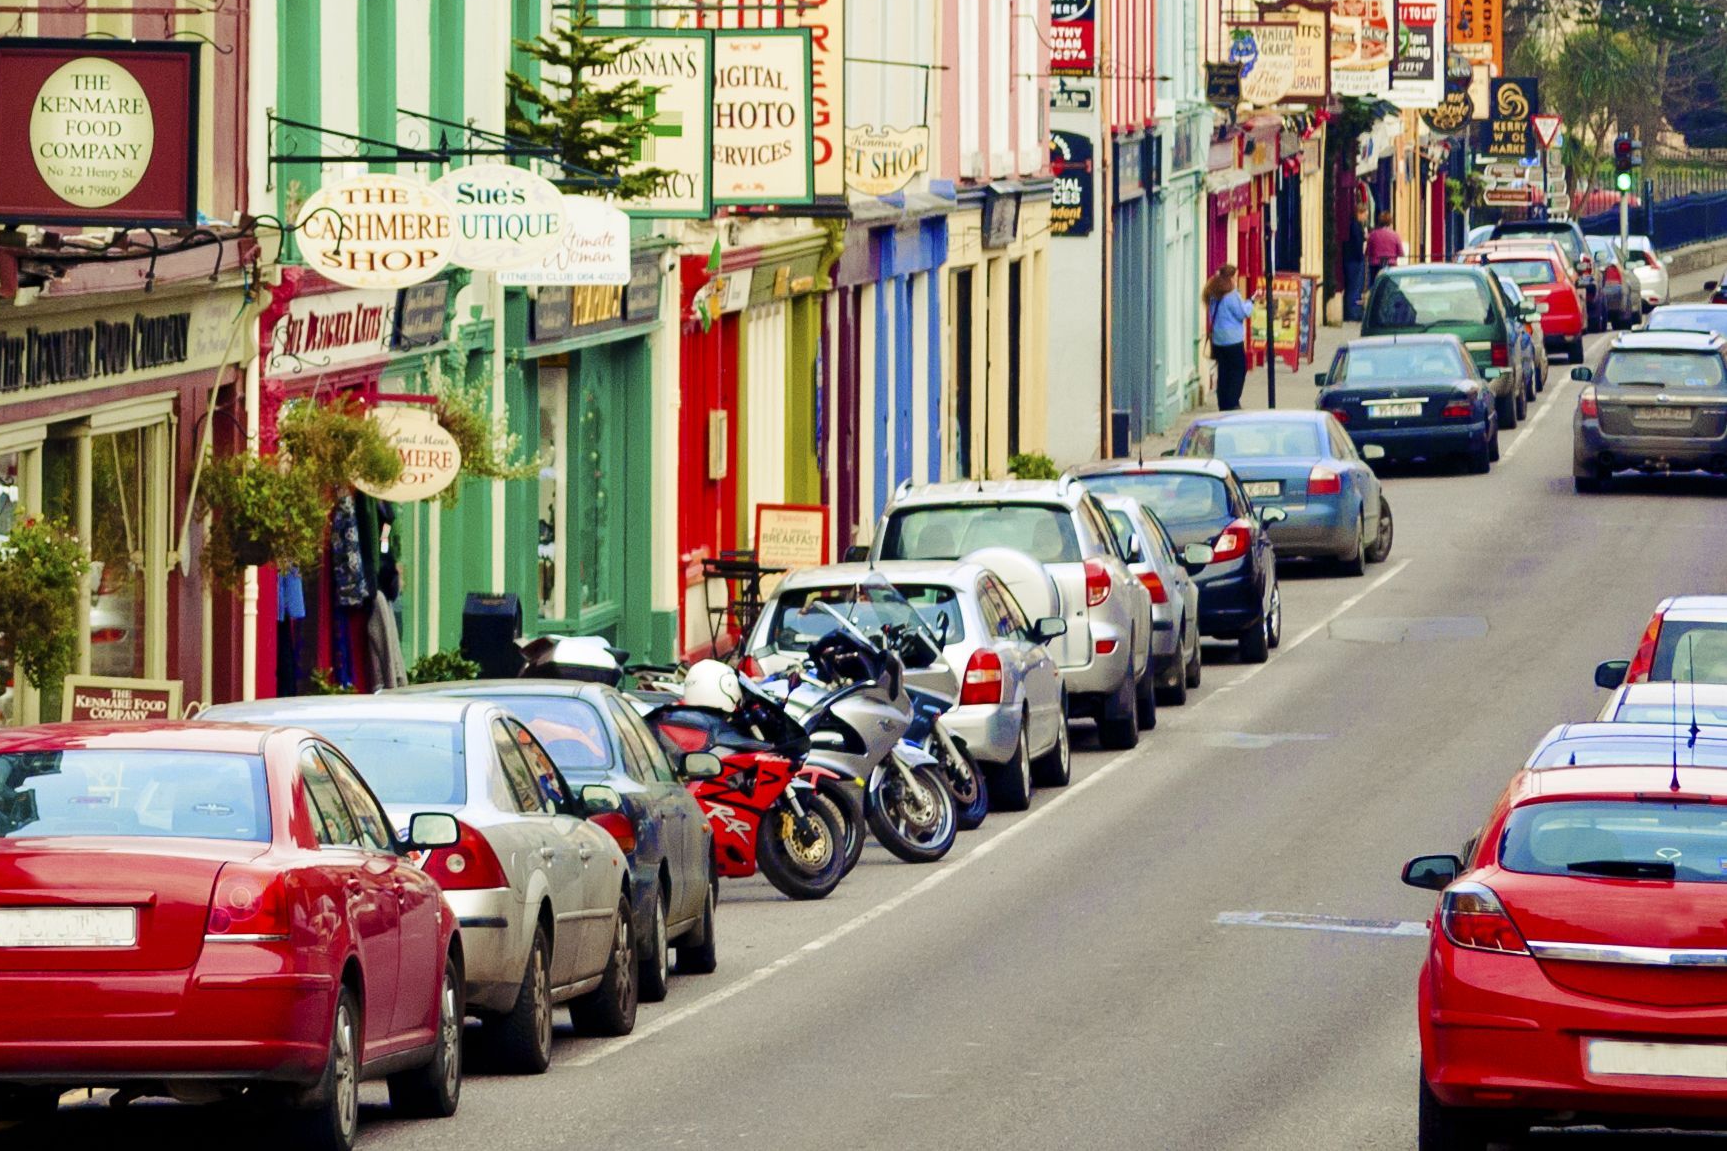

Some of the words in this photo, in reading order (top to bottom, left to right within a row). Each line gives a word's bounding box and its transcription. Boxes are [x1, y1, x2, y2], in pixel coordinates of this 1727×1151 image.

[71, 74, 111, 91] THE
[714, 65, 789, 91] IGITAL
[40, 96, 145, 115] KENMARE
[715, 101, 795, 130] HOTO
[65, 119, 122, 137] FOOD
[40, 142, 142, 161] COMPANY
[713, 140, 792, 167] ERVICES
[871, 144, 923, 179] SHOP
[70, 166, 83, 177] 22
[86, 167, 120, 180] Henry
[64, 185, 84, 196] 064
[340, 188, 410, 205] THE
[456, 181, 526, 206] Sue's
[302, 213, 451, 241] CASHMERE
[459, 213, 559, 245] UTIQUE
[320, 249, 440, 271] SHOP
[75, 695, 132, 710] KENMARE
[134, 698, 167, 712] FOOD
[111, 689, 132, 699] THE
[89, 708, 149, 721] COMPANY
